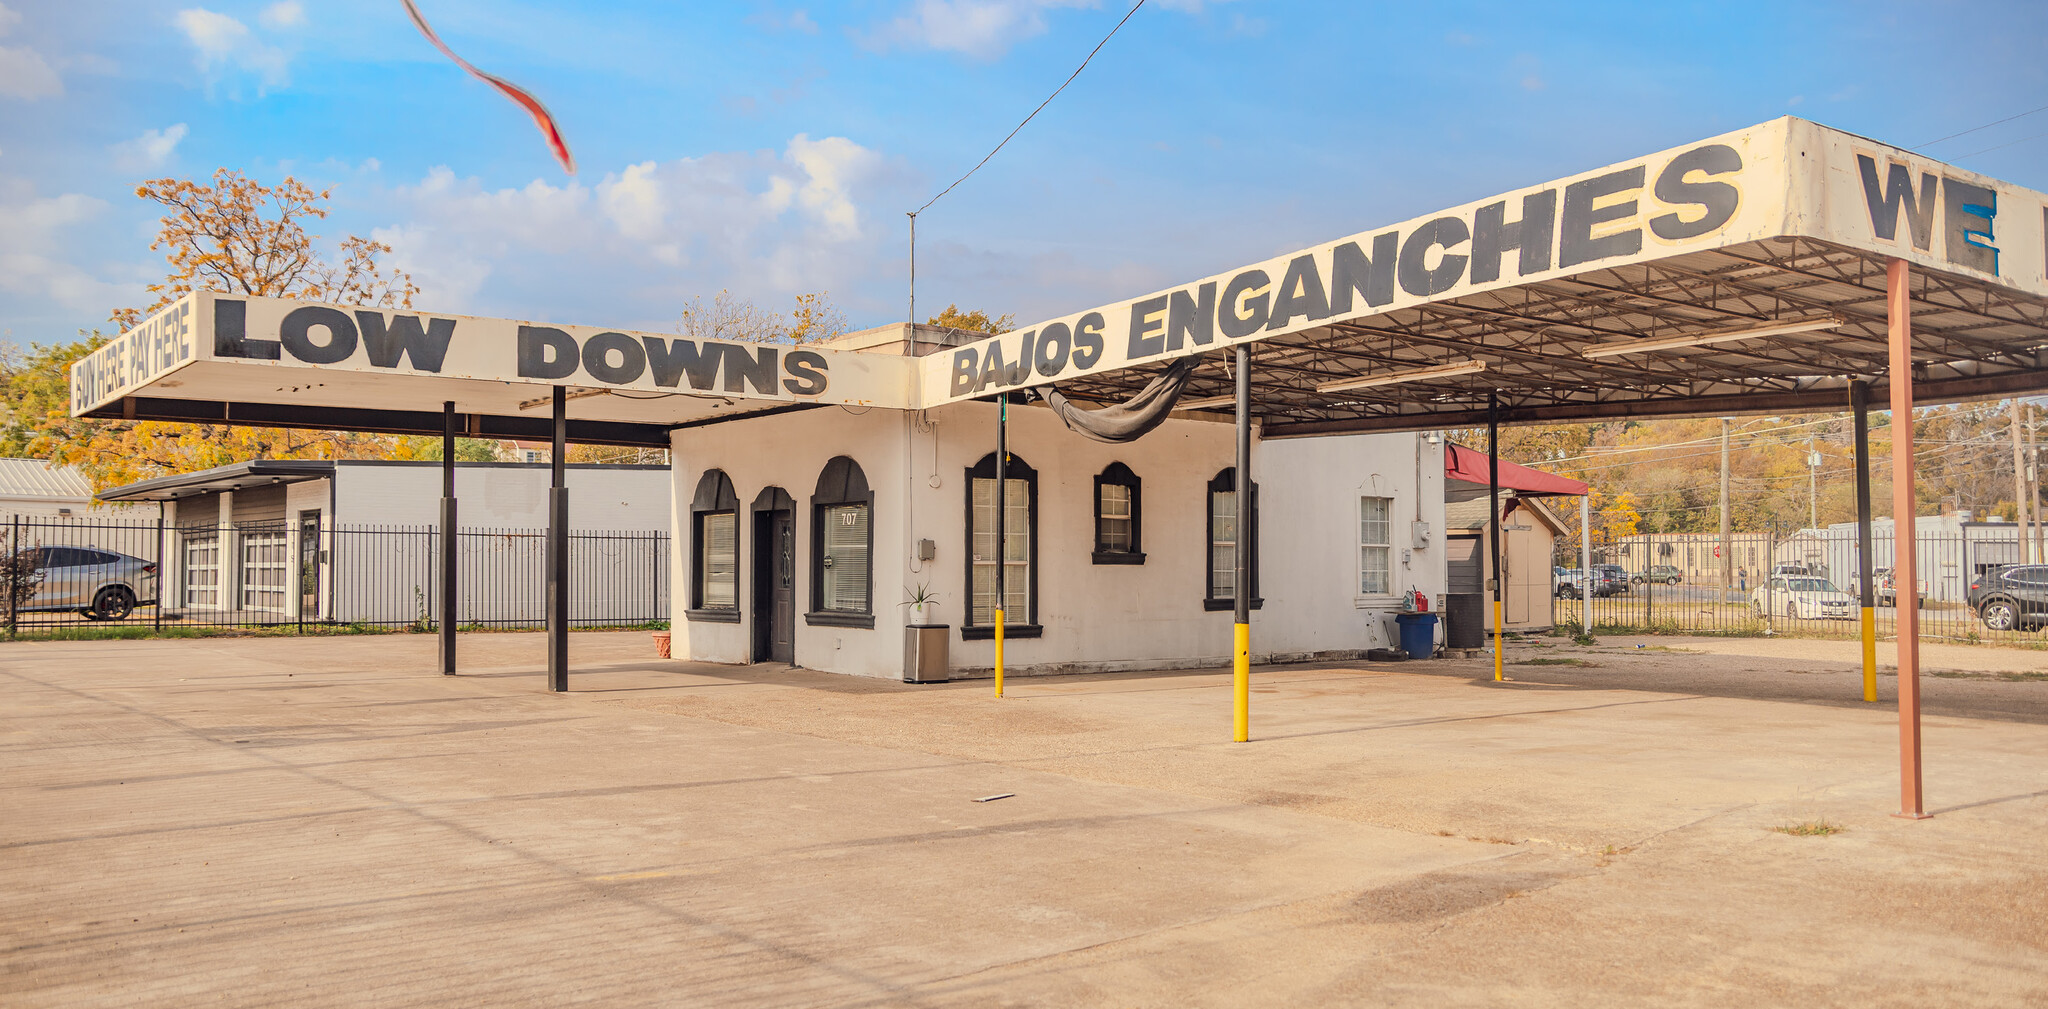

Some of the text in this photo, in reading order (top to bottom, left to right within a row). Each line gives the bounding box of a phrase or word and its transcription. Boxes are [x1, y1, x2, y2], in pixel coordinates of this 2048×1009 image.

[1857, 153, 2000, 278] WE
[950, 144, 1744, 398] BAJOS ENGANCHES
[76, 301, 190, 411] BUY HERE PAY HERE
[214, 299, 829, 397] LOW DOWNS
[841, 513, 857, 526] 707
